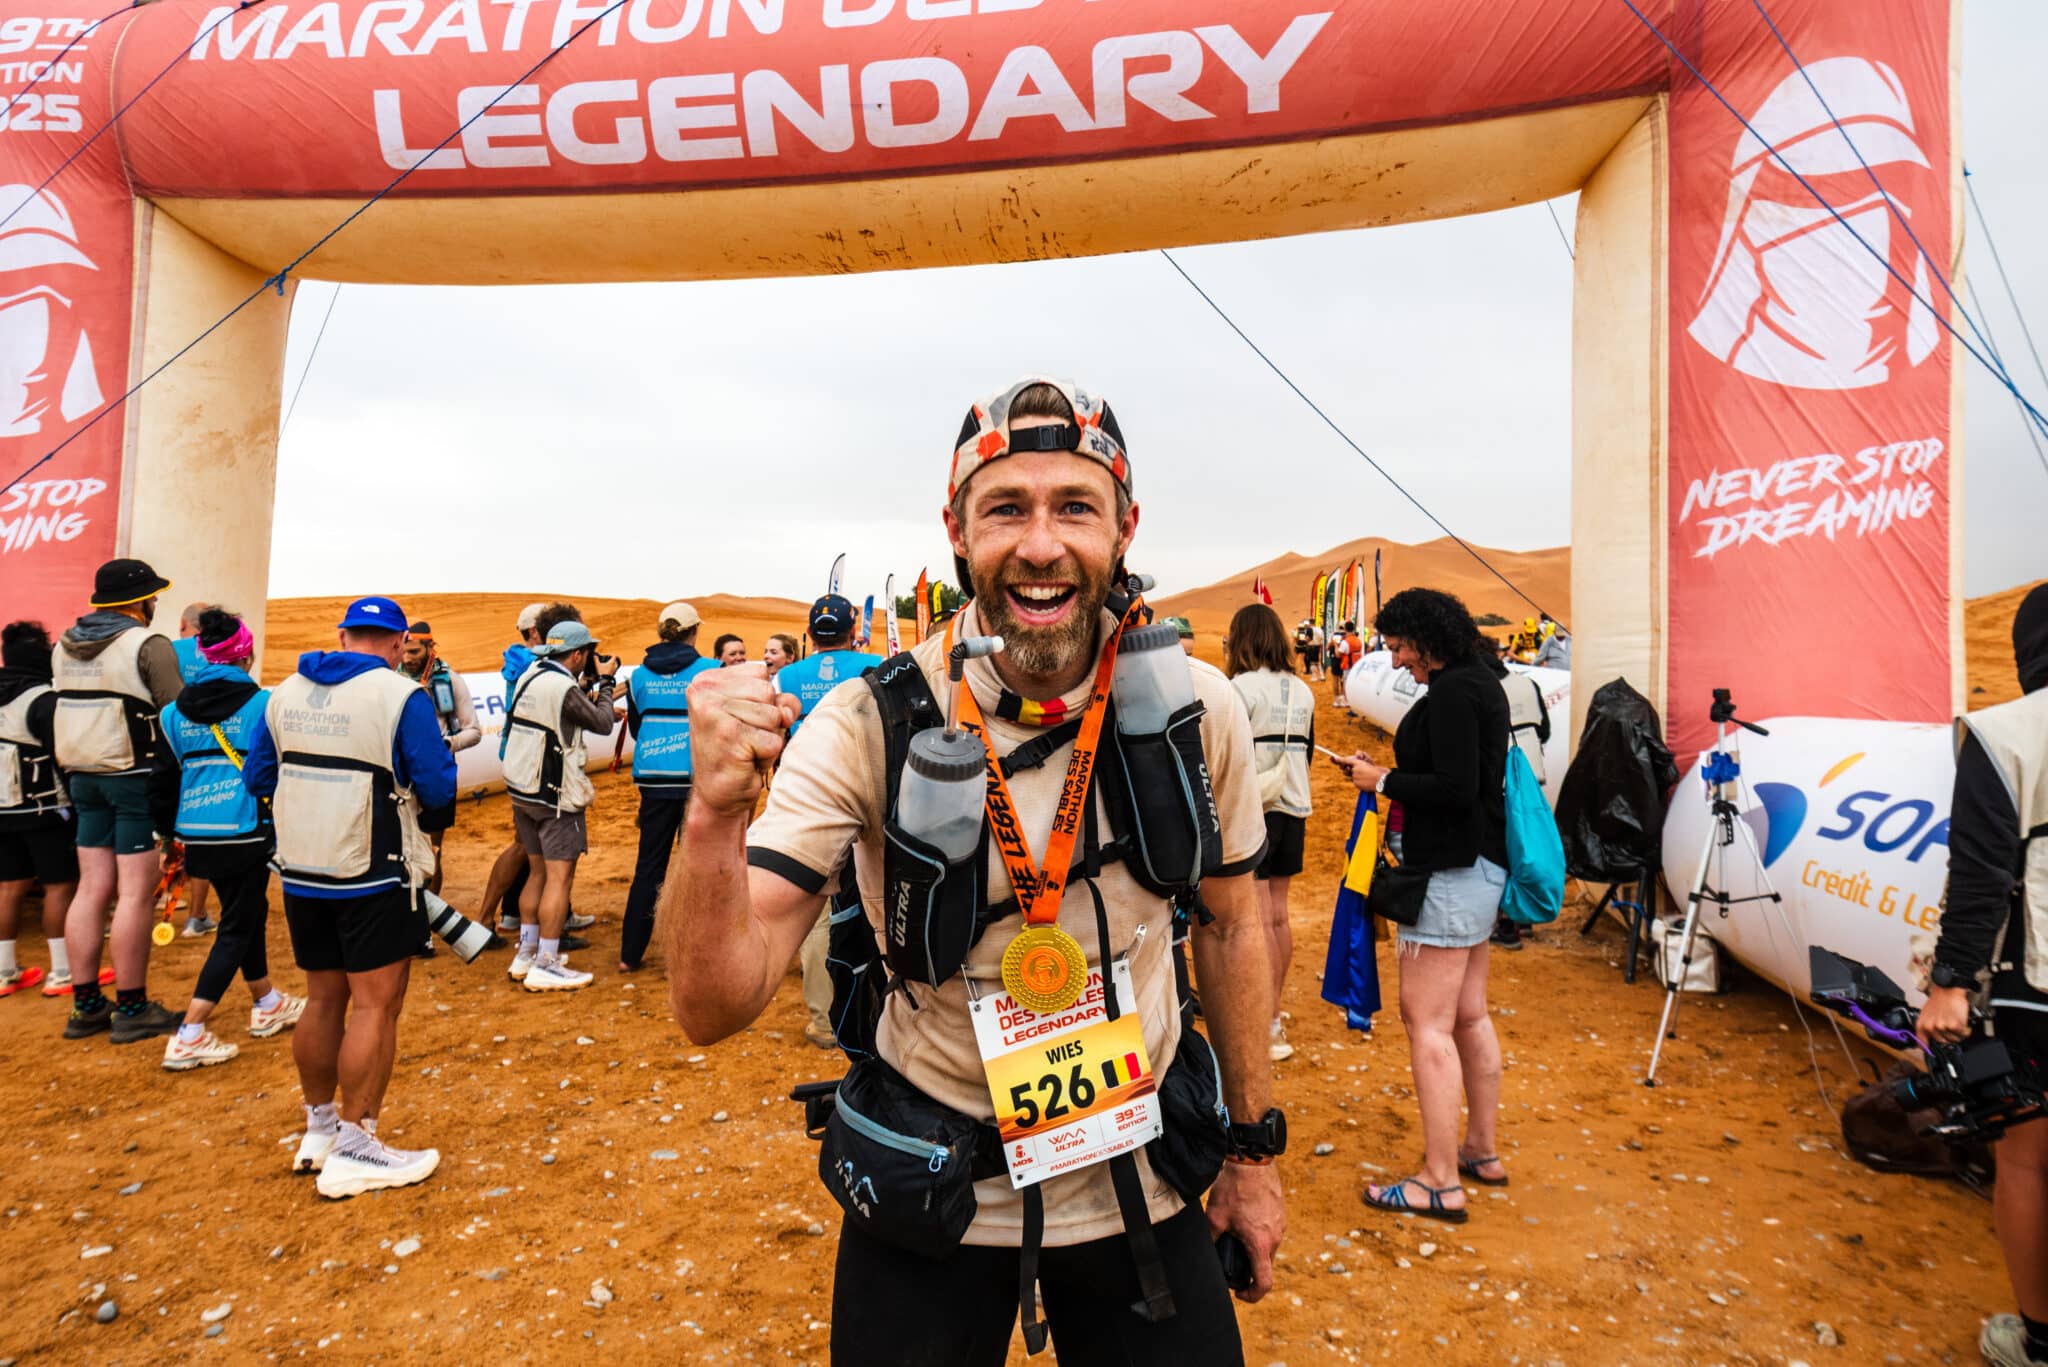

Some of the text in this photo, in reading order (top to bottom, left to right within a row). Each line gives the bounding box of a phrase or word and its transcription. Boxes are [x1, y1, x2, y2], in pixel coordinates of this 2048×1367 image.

[188, 0, 787, 60] MARATHON
[372, 11, 1333, 170] LEGENDARY
[0, 477, 107, 513] STOP
[1680, 437, 1945, 525] NEVER STOP
[1690, 481, 1935, 560] DREAMING
[283, 708, 351, 725] MARATHON
[283, 721, 350, 737] DES SABLES
[1052, 749, 1082, 833] DES SABLES
[1063, 750, 1092, 835] MARATHON
[1801, 859, 1873, 909] Crédit
[1878, 884, 1900, 917] &
[895, 880, 912, 947] ULTRA
[999, 1009, 1036, 1031] DES
[1003, 1006, 1108, 1047] LEGENDARY
[1046, 1040, 1084, 1065] WIES
[1009, 1063, 1096, 1129] 526
[1117, 1115, 1149, 1132] EDITION
[338, 1150, 389, 1168] SALOMON
[1012, 1157, 1034, 1169] MDS
[1055, 1138, 1085, 1153] ULTRA
